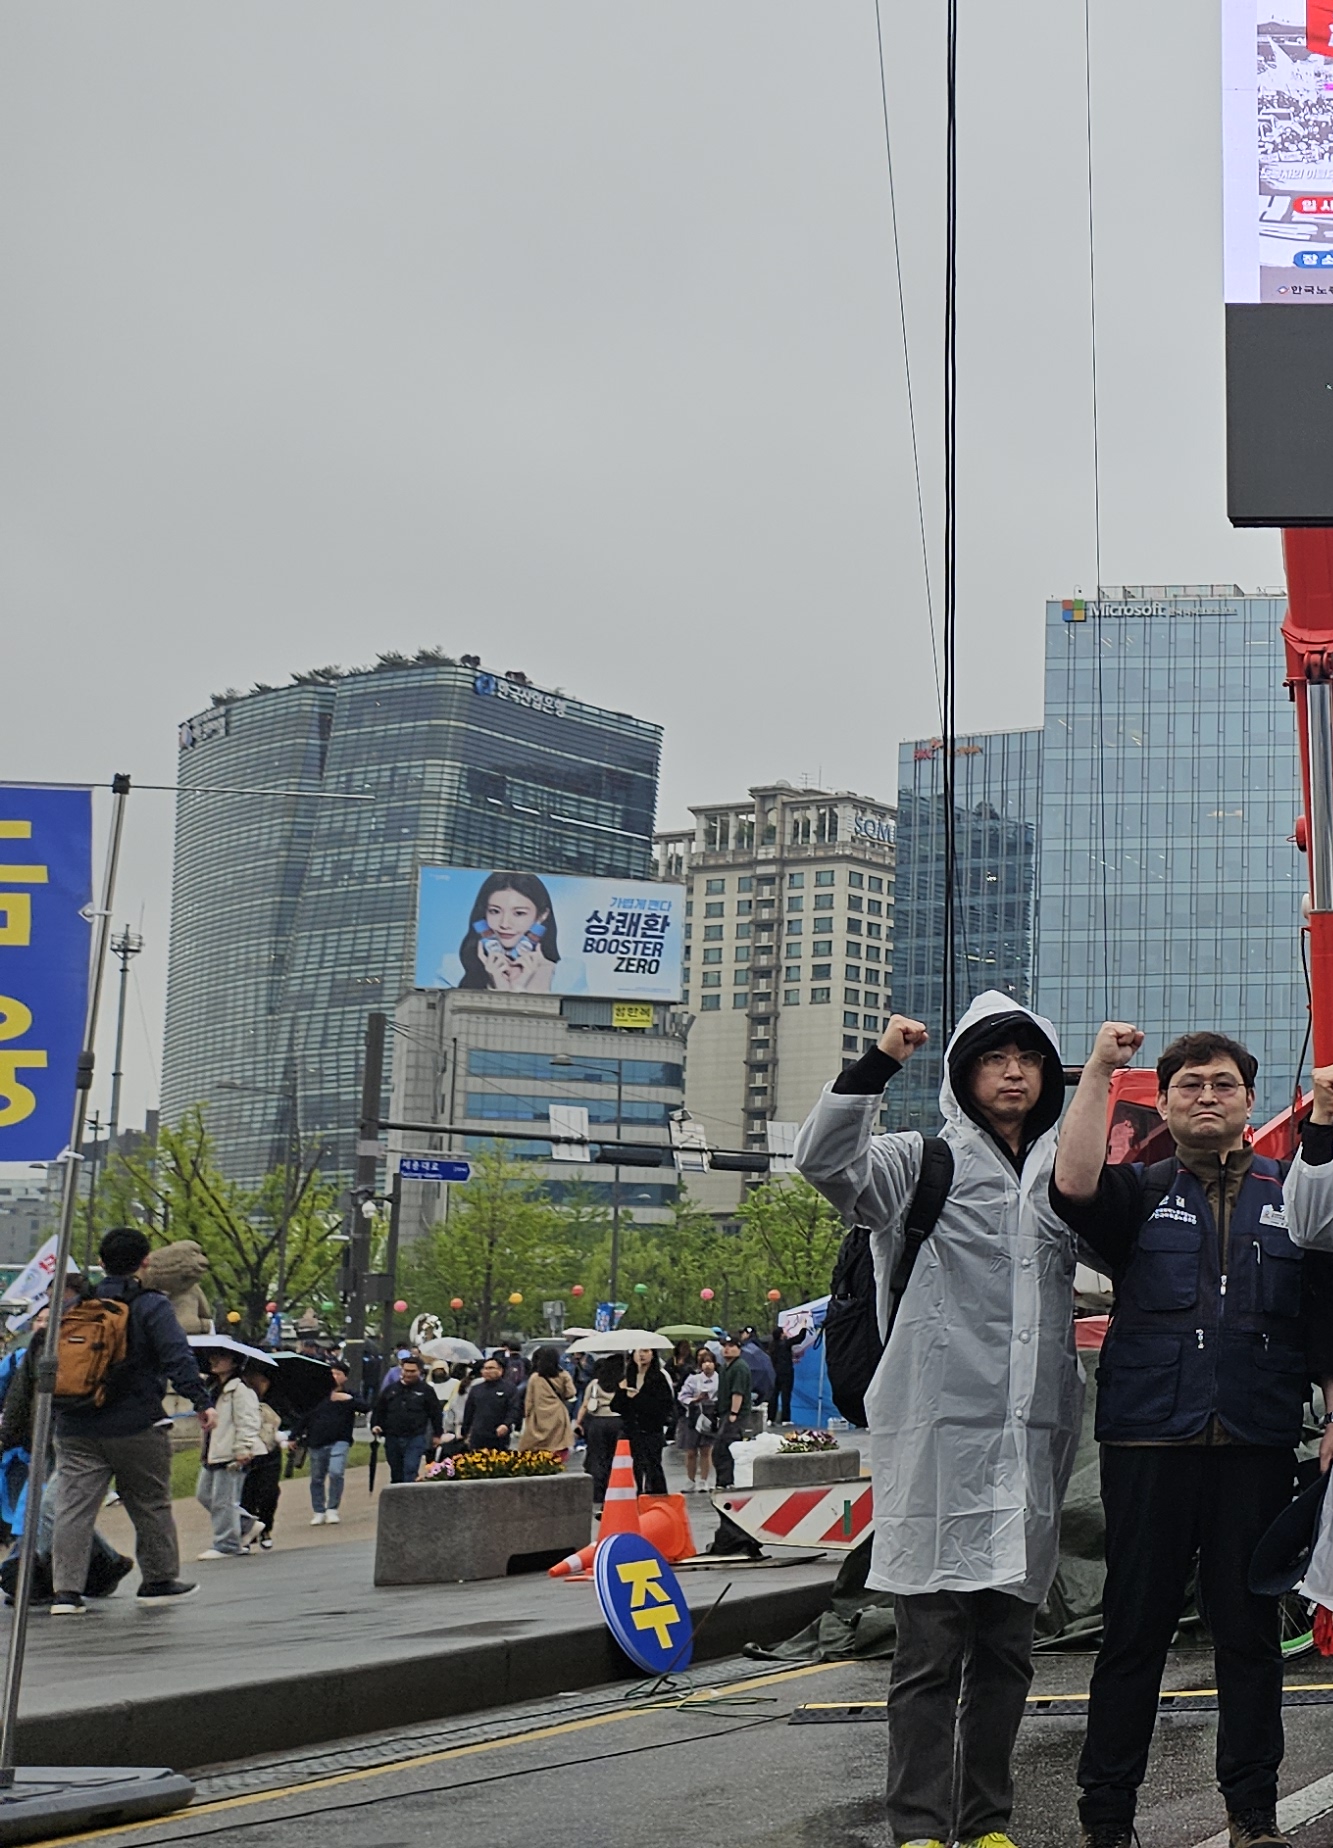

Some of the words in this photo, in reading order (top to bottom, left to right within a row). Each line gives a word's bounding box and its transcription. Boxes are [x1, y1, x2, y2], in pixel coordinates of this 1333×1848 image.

[1089, 602, 1166, 617] Microsoft
[497, 680, 566, 718] 한국산업은행
[854, 814, 896, 843] SOM
[585, 910, 671, 940] 상쾌환
[583, 937, 664, 957] BOOSTER
[614, 957, 660, 975] ZERO
[615, 1558, 681, 1649] 주
